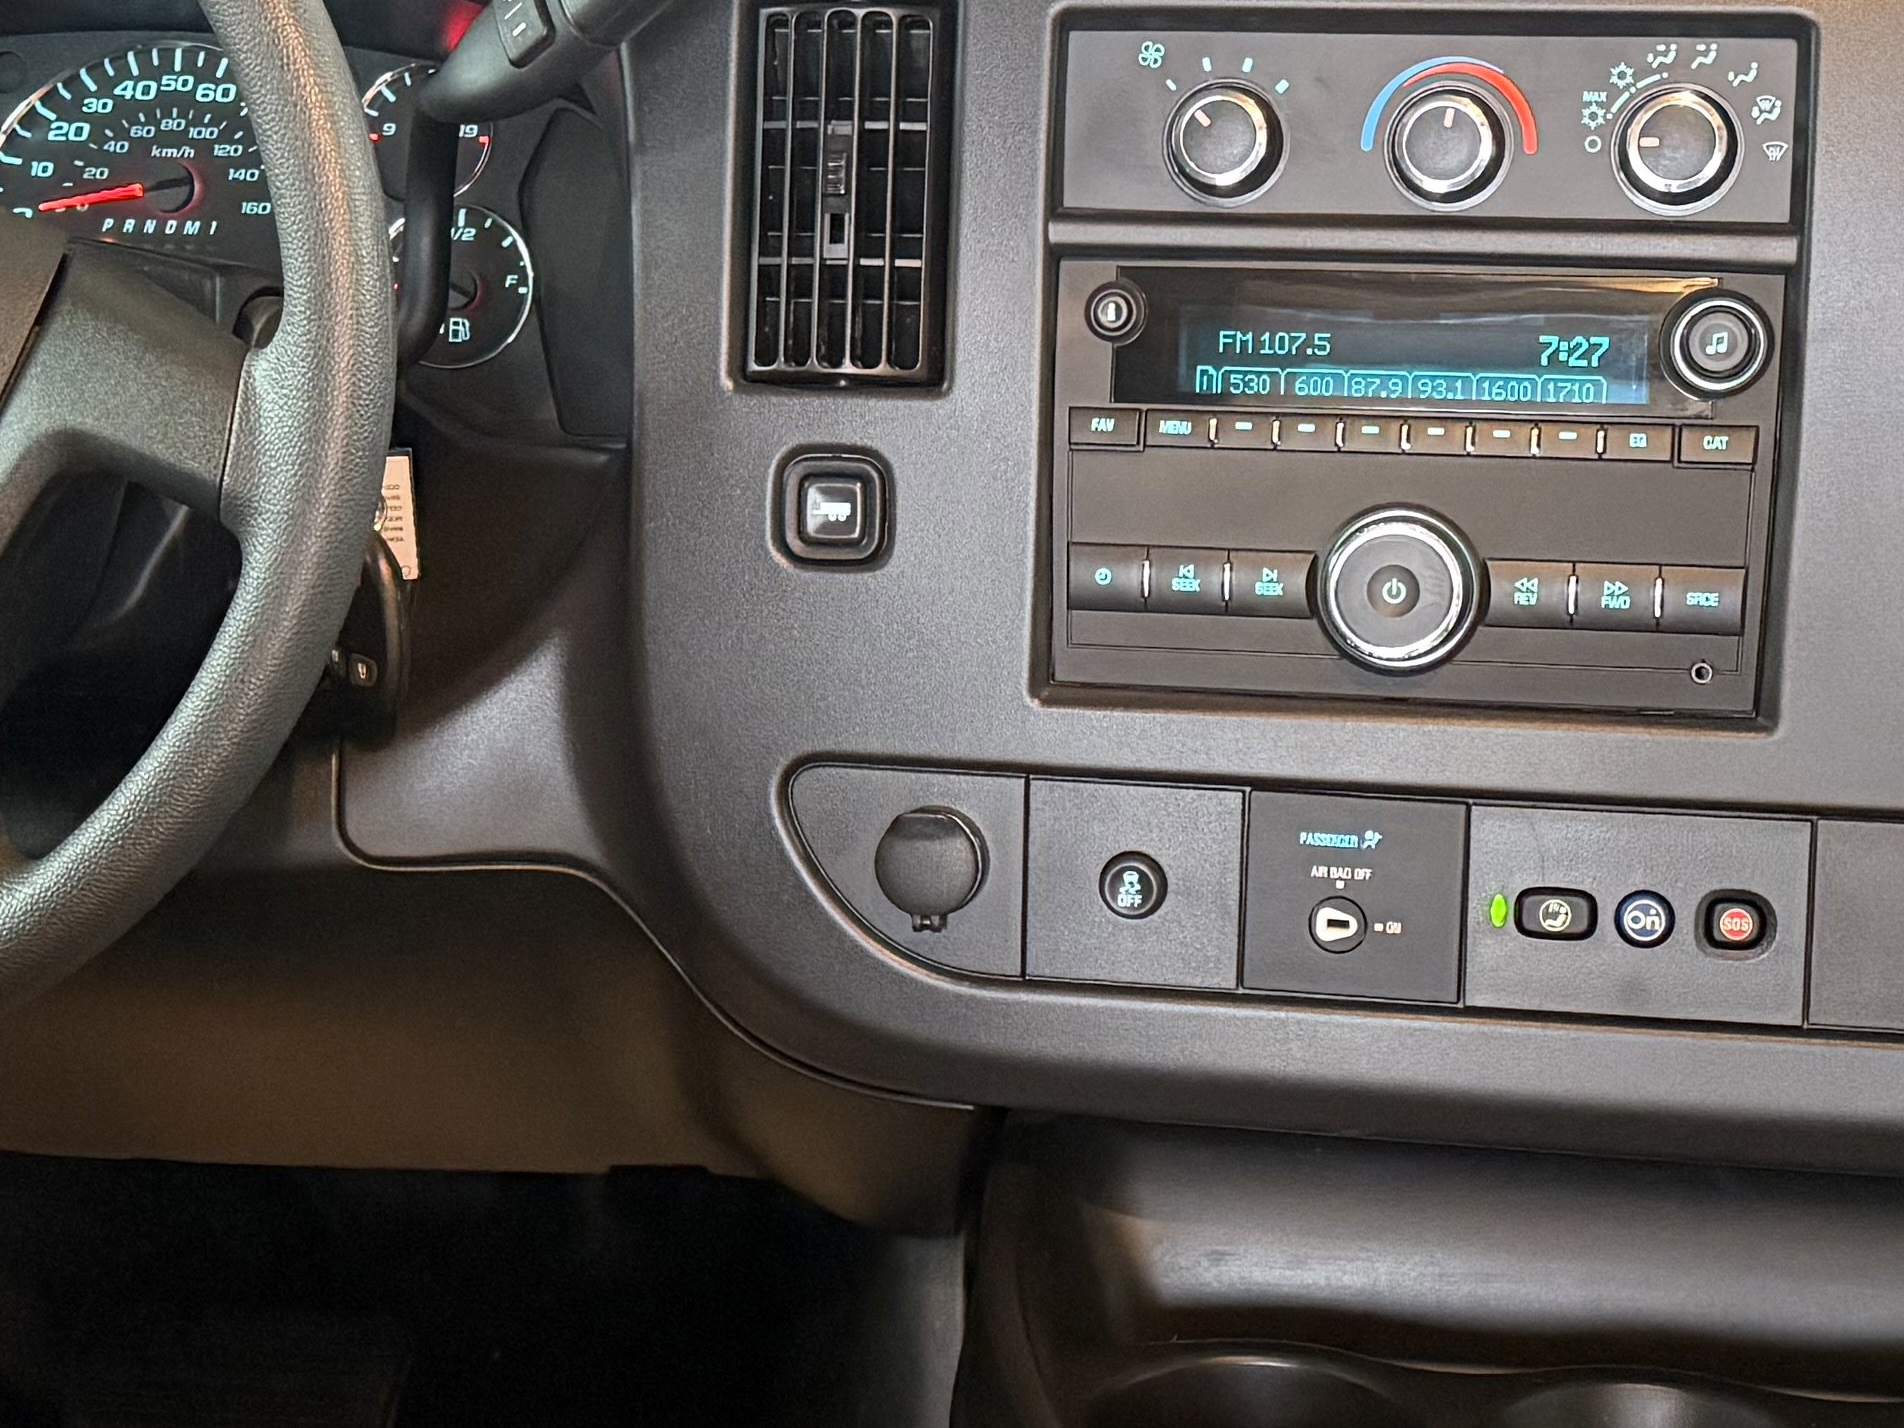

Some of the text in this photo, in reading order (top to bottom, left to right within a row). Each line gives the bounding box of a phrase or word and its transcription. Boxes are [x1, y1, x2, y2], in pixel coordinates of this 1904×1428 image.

[113, 80, 157, 100] 40
[160, 75, 194, 92] 50
[196, 83, 237, 103] 60
[1583, 91, 1607, 102] MAX
[82, 98, 114, 113] 30
[48, 122, 90, 141] 20
[130, 126, 155, 138] 60
[160, 119, 186, 131] 80
[383, 123, 396, 136] 9
[459, 124, 479, 137] 19
[188, 127, 219, 140] 100
[103, 141, 129, 153] 40
[150, 144, 195, 159] km/h
[213, 144, 244, 157] 120
[30, 162, 54, 178] 10
[83, 167, 109, 180] 20
[228, 168, 259, 181] 140
[241, 202, 272, 215] 160
[102, 218, 114, 233] P
[505, 275, 518, 288] F
[1218, 330, 1331, 356] FM 107.5
[1538, 336, 1610, 368] 7:27
[1230, 374, 1270, 395] 530
[1295, 375, 1333, 397] 600
[1351, 378, 1403, 399] 87.9
[1418, 378, 1465, 400] 93.1
[1481, 380, 1531, 402] 1600
[1547, 381, 1594, 403] 1710
[1090, 418, 1115, 432] FAV
[1159, 420, 1192, 435] MENU
[1703, 435, 1729, 450] CAT
[1171, 578, 1201, 592] SEEK
[1254, 582, 1284, 596] SEEK
[1514, 591, 1538, 606] REV
[1601, 594, 1630, 610] FWD
[1310, 865, 1328, 878] AIR
[1353, 868, 1373, 880] OFF
[1117, 894, 1143, 908] OFF
[1627, 909, 1660, 930] On
[1723, 919, 1749, 932] SOS
